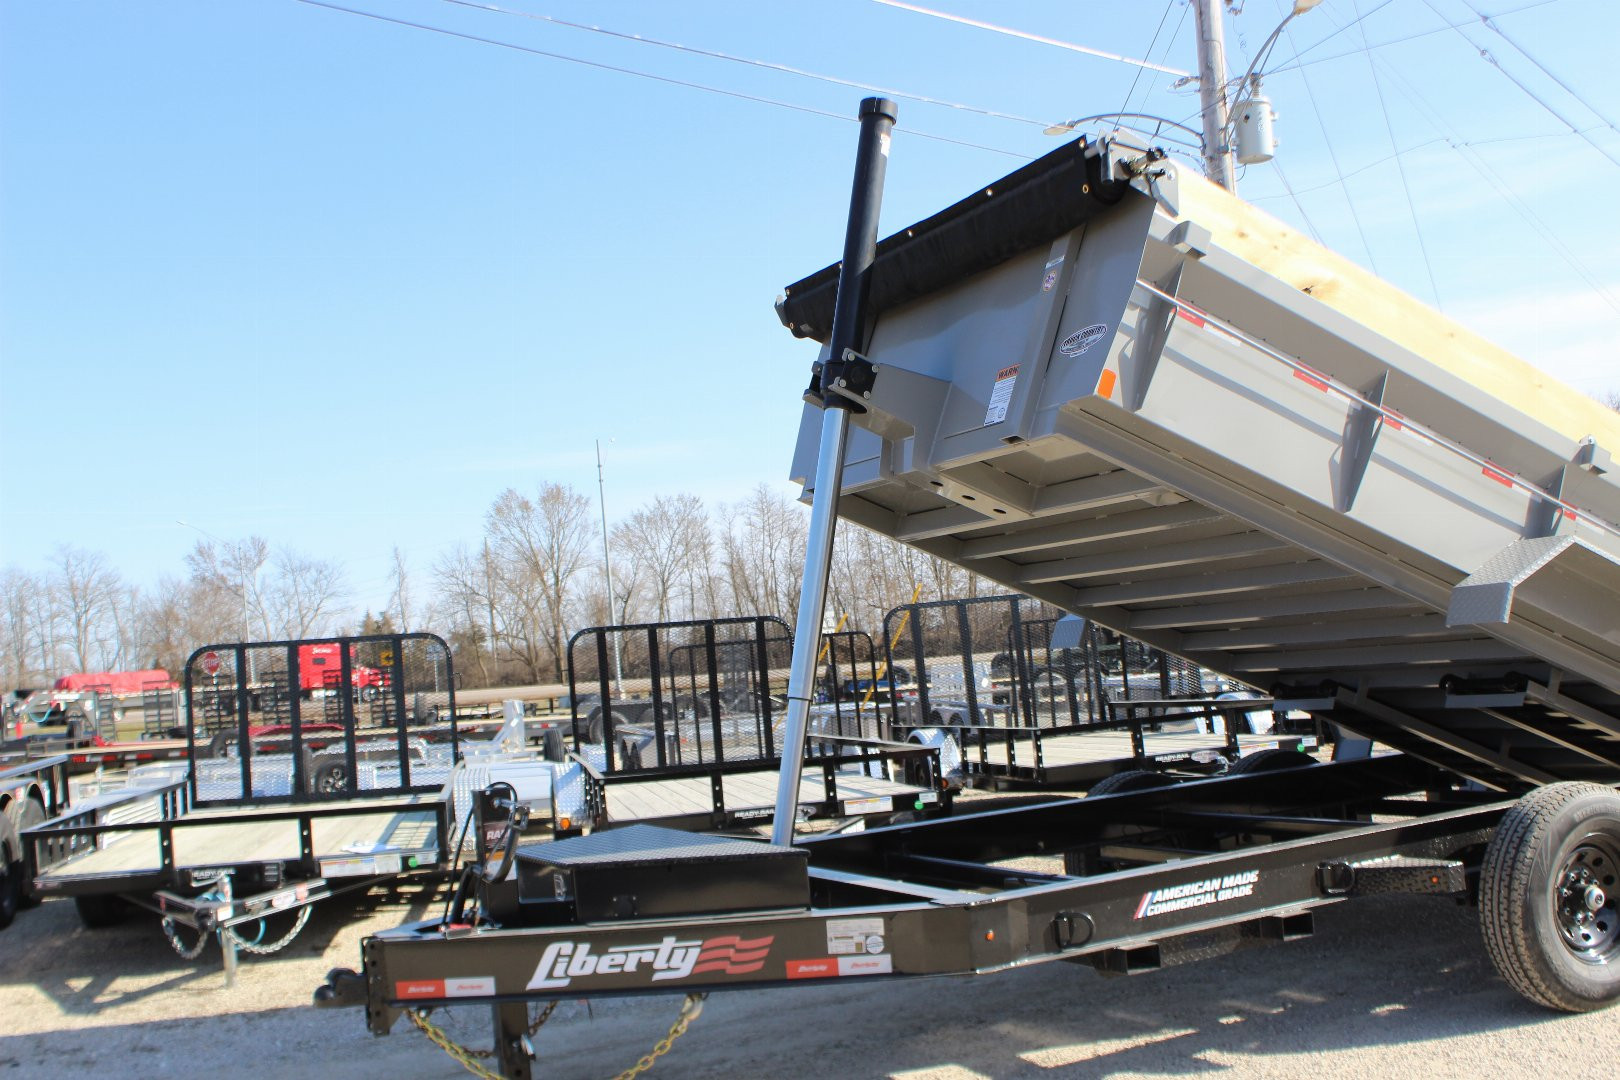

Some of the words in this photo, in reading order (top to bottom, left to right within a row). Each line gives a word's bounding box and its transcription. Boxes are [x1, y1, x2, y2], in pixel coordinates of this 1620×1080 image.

[998, 366, 1018, 379] WARN
[1146, 890, 1217, 917] COMMERCIAL
[1217, 883, 1254, 902] GRADE
[1152, 878, 1221, 903] AMERICAN
[1221, 869, 1260, 889] MADE
[525, 936, 703, 991] Liberty
